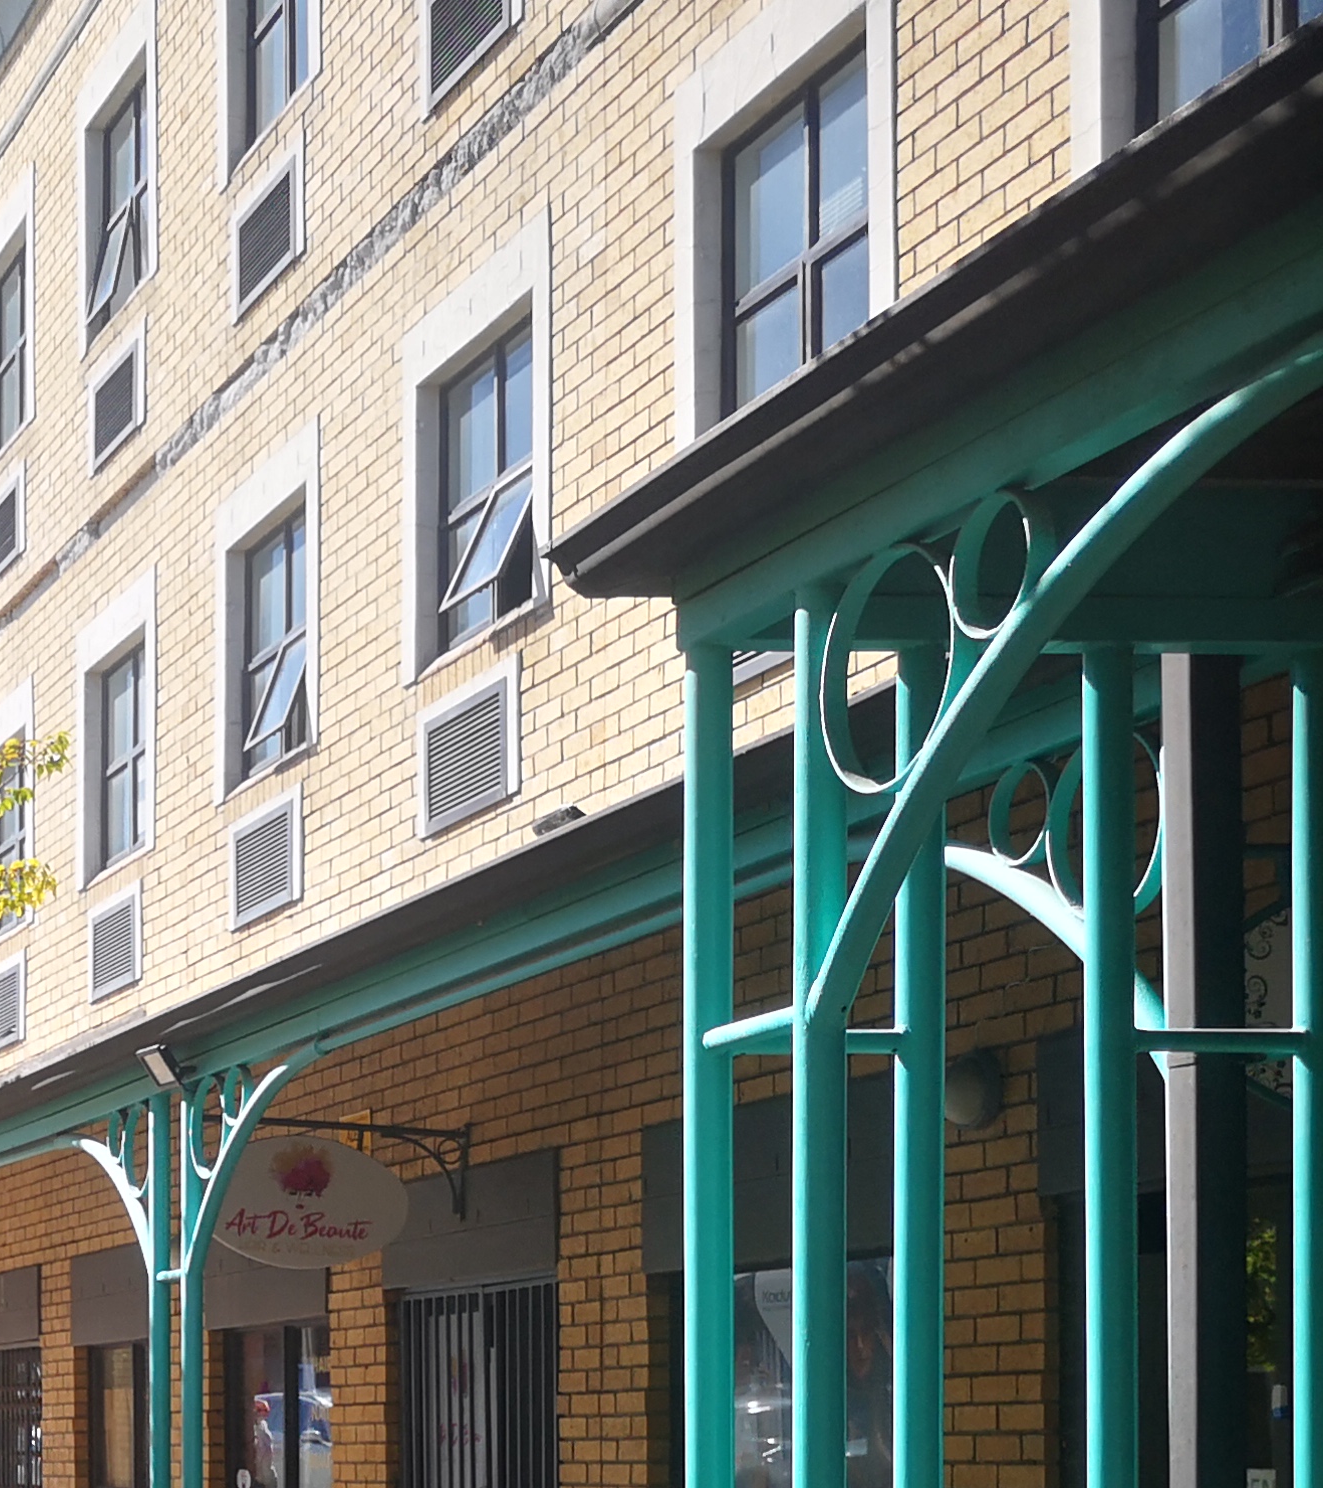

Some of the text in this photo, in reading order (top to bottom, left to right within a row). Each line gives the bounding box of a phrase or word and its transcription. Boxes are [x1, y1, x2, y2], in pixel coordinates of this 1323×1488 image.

[225, 1208, 372, 1240] Art De Beaute
